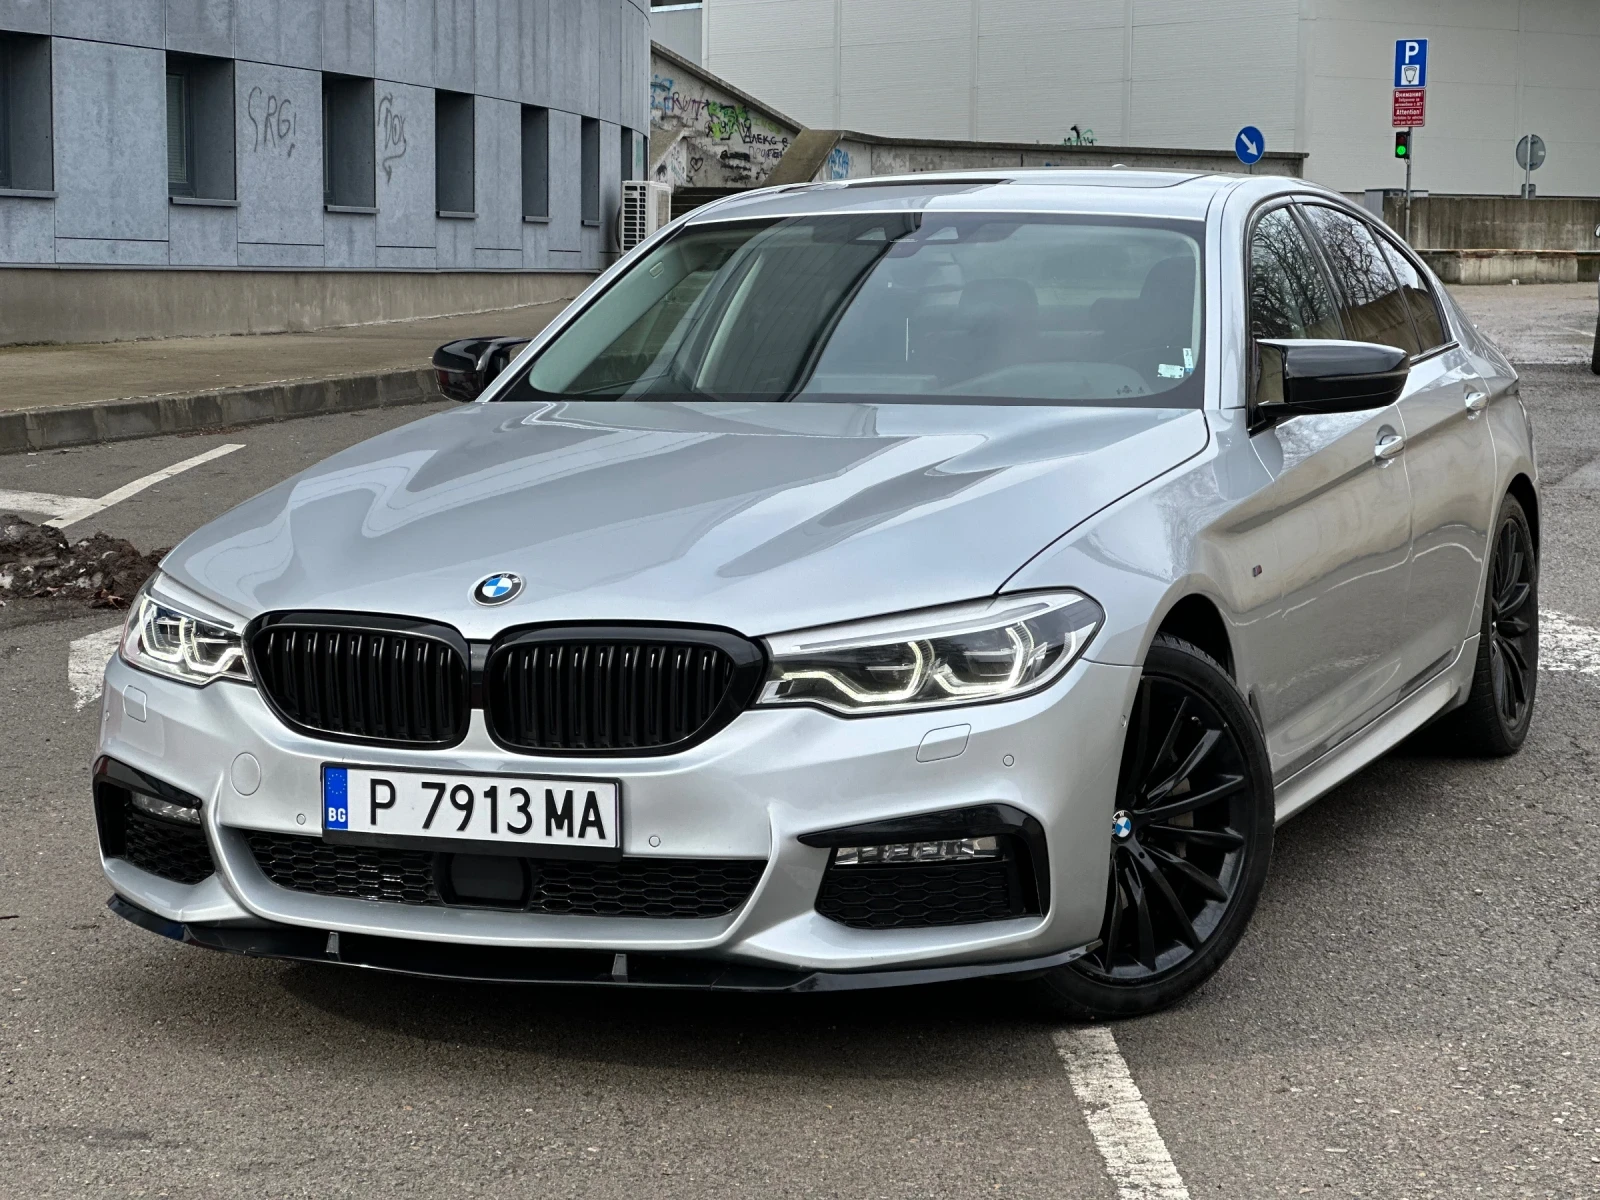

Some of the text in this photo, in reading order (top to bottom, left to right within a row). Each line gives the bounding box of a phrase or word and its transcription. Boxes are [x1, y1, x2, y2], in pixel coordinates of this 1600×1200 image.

[1405, 41, 1419, 64] P
[328, 807, 346, 823] BG
[370, 778, 606, 840] P 7913 MA
